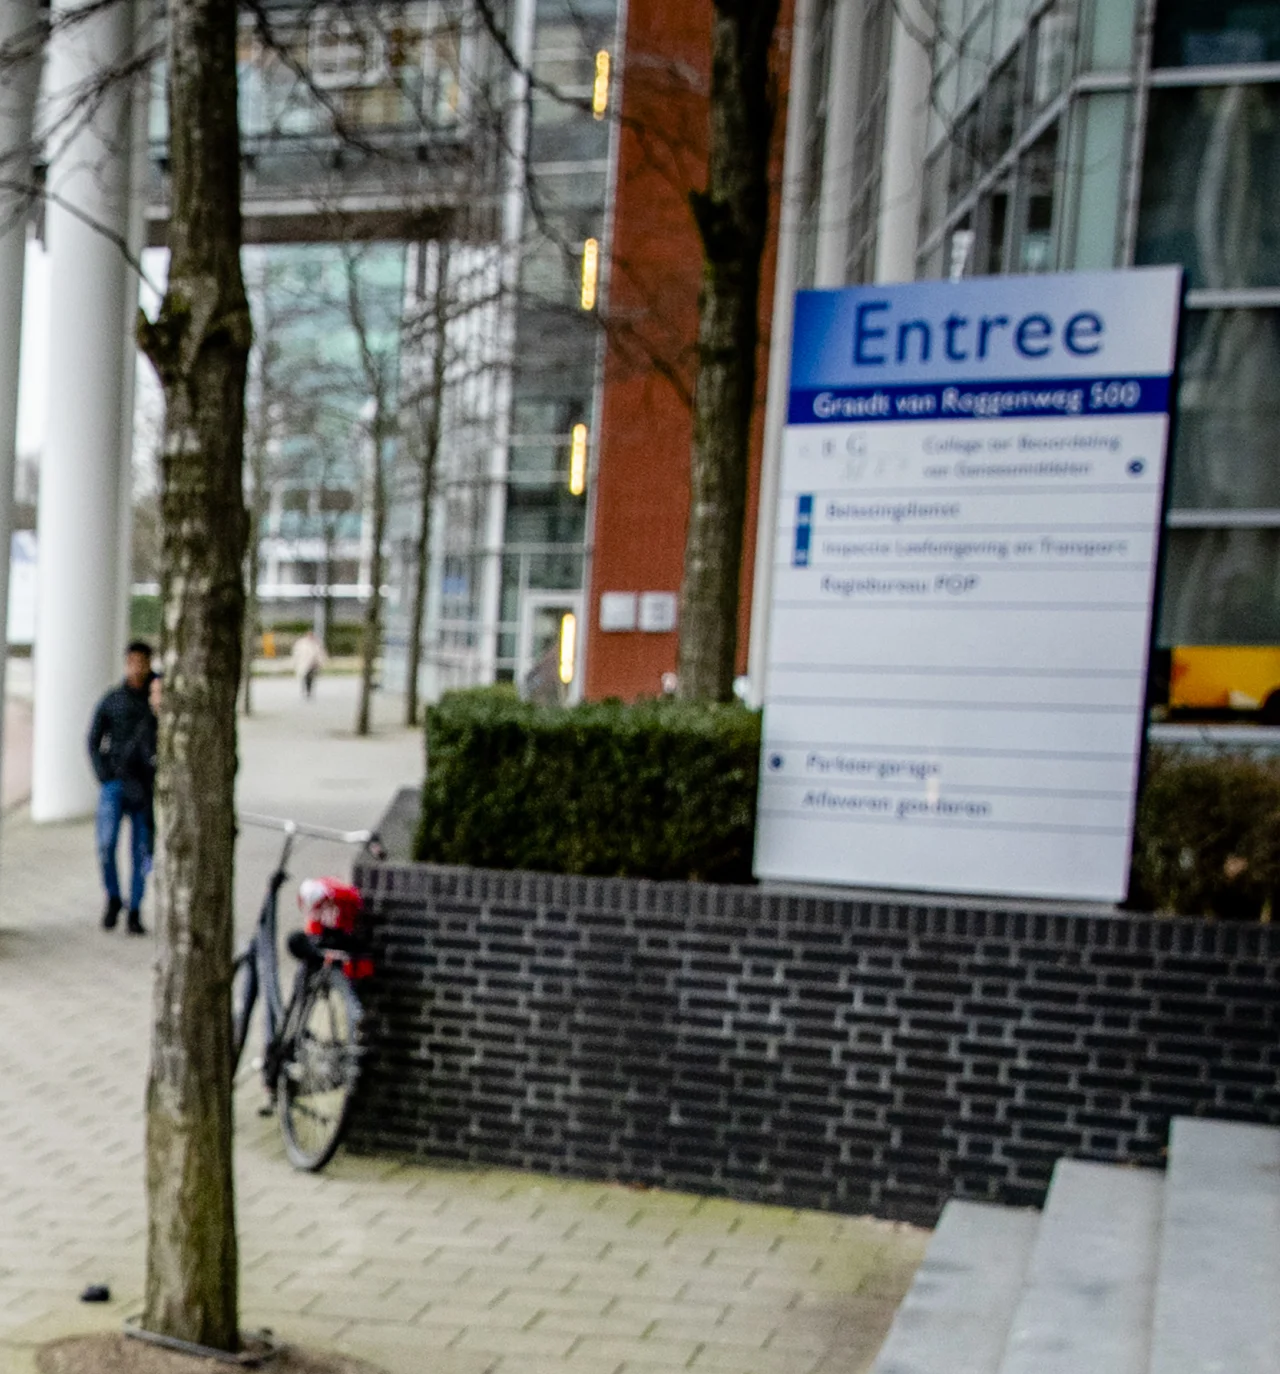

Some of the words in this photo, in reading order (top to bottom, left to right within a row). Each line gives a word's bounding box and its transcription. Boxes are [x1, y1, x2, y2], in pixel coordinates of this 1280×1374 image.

[853, 300, 1104, 366] Entree
[813, 389, 891, 418] Graadt
[895, 393, 937, 415] van
[942, 386, 1083, 419] Roggenweg
[1090, 380, 1141, 409] 500
[934, 573, 980, 595] POP
